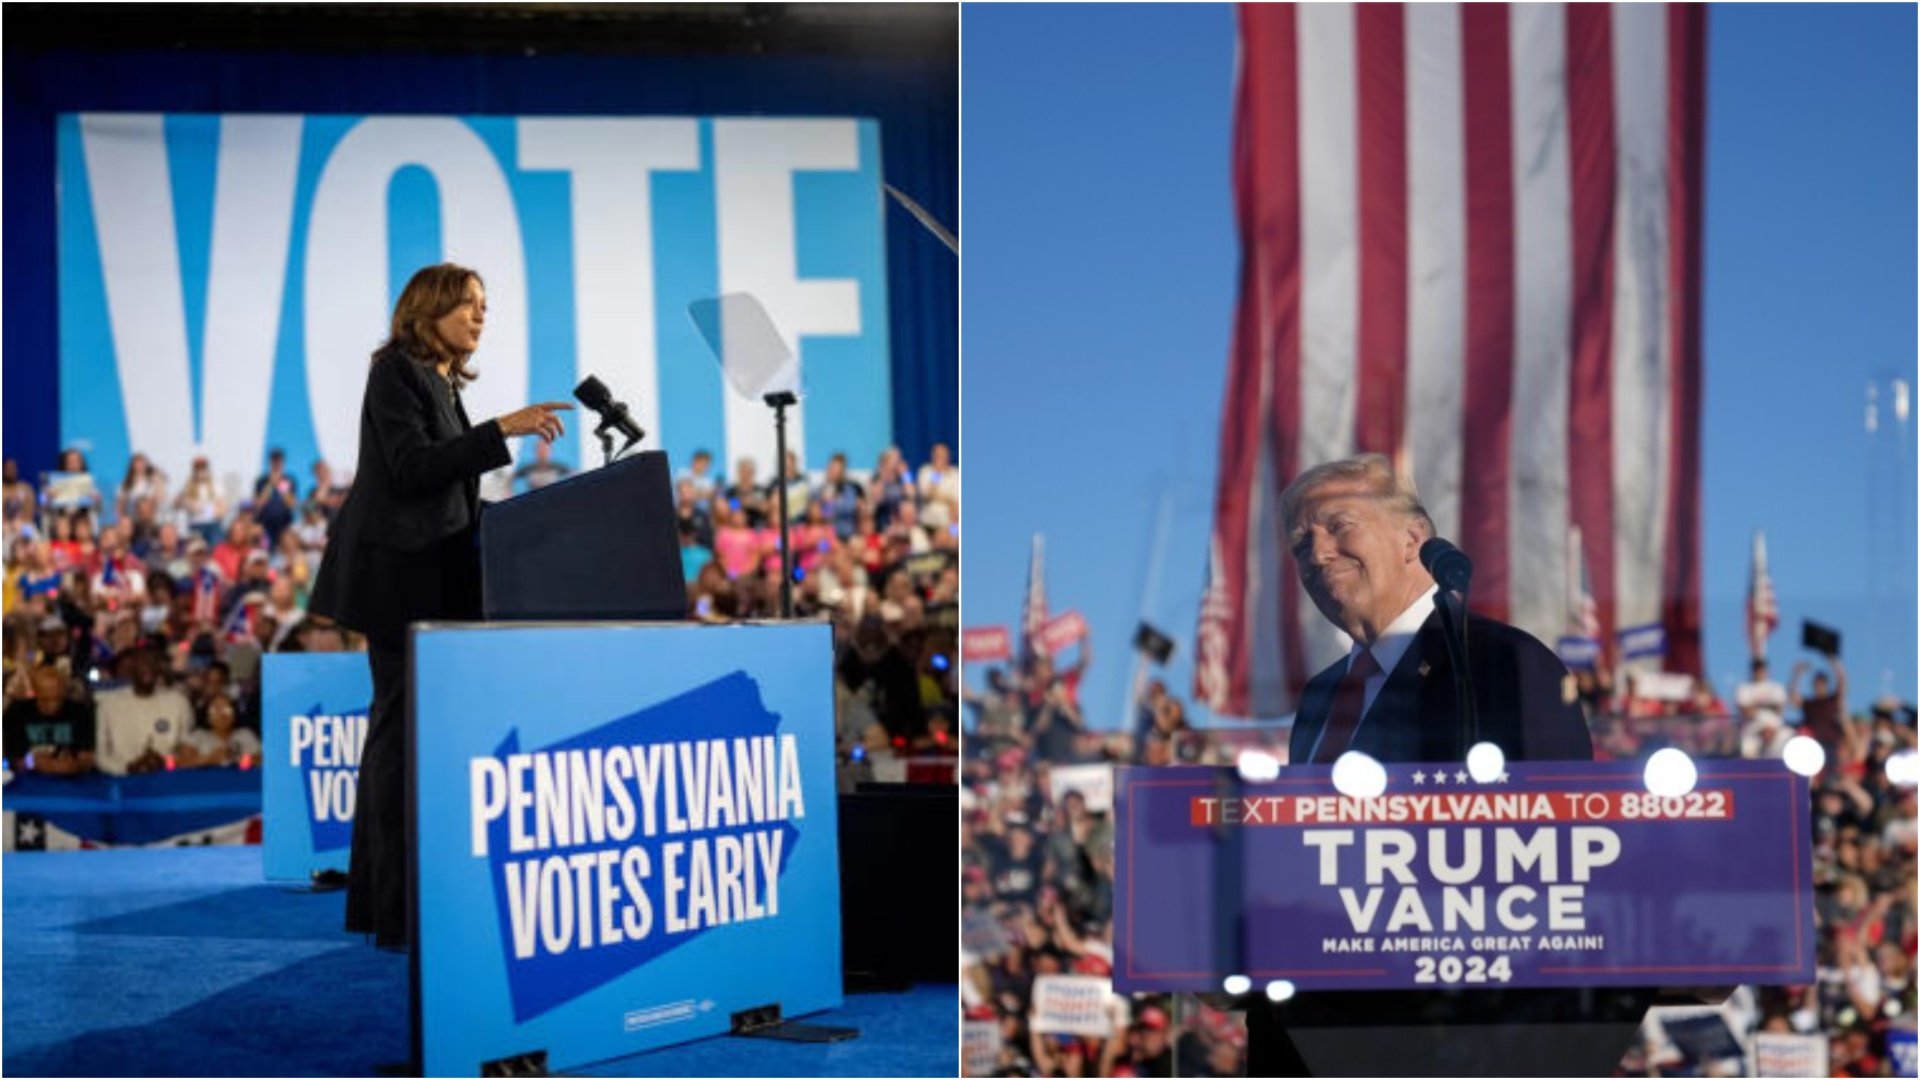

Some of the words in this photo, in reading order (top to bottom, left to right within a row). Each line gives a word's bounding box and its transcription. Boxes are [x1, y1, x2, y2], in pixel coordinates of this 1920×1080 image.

[79, 113, 862, 482] VOTE
[309, 768, 360, 822] VO
[470, 733, 804, 858] PENNSYLVANIA
[1199, 797, 1284, 825] TEXT
[1295, 794, 1555, 823] PENNSYLVANIA
[1565, 793, 1610, 820] TO
[1620, 791, 1725, 818] 88022
[1303, 826, 1621, 886] TRUMP
[505, 845, 653, 960] VOTES
[662, 829, 783, 935] EARLY
[1339, 885, 1586, 933] VANCE
[1322, 938, 1375, 953] MAKE
[1381, 937, 1465, 952] AMERICA
[1471, 936, 1532, 951] GREAT
[1538, 935, 1603, 951] AGAIN!
[1414, 956, 1512, 983] 2024
